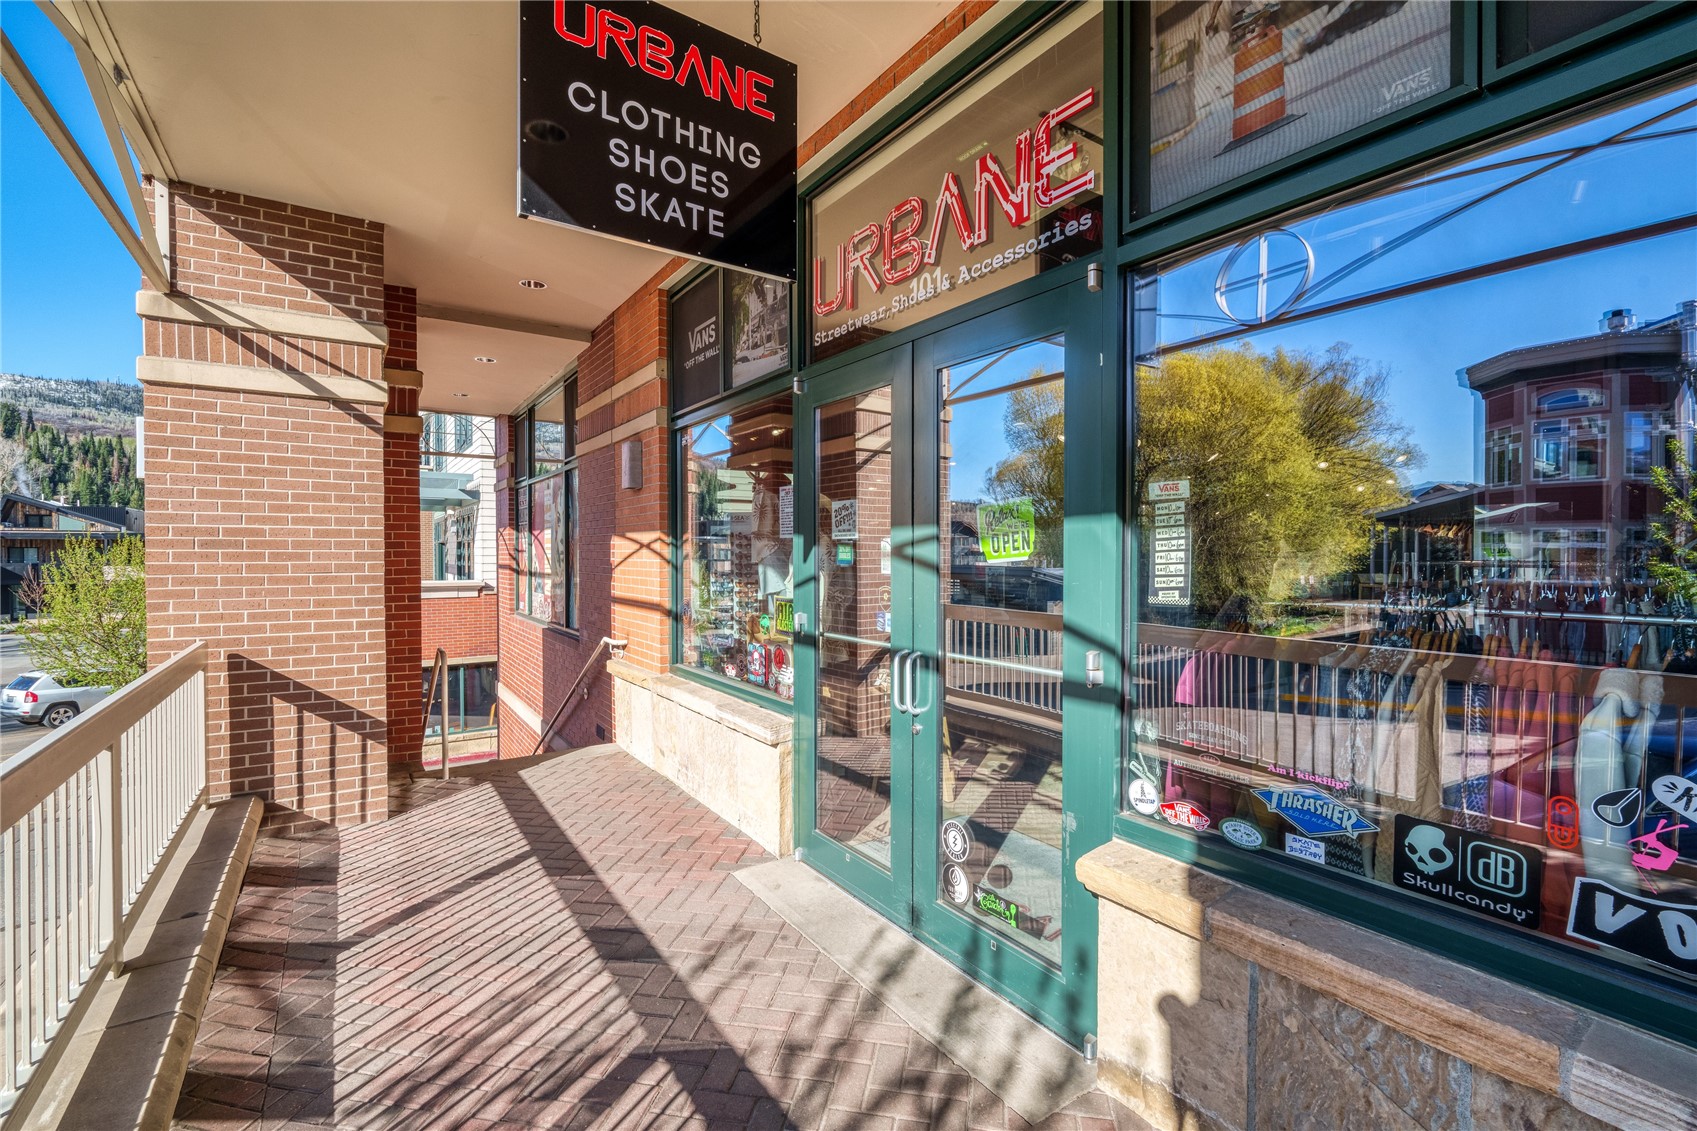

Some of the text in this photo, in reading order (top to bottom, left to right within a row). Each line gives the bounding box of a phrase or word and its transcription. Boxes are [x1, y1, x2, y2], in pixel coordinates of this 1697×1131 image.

[554, 0, 775, 121] URBANE
[1382, 66, 1432, 100] VANS
[567, 82, 761, 169] CLOTHING
[609, 138, 729, 198] SHOES
[615, 183, 724, 238] SKATE
[814, 87, 1095, 316] URBANE
[957, 212, 1093, 287] Accessories
[688, 316, 716, 354] VANS
[1158, 483, 1179, 492] VANS
[834, 503, 849, 519] 20%
[991, 530, 1031, 555] OPEN
[1176, 720, 1248, 745] SKATEBOARDING
[1267, 764, 1350, 791] Am I kickflip?
[1174, 803, 1192, 814] VANS
[1177, 811, 1188, 822] THE
[1269, 786, 1359, 838] THRASHER
[1292, 837, 1320, 848] SKATE
